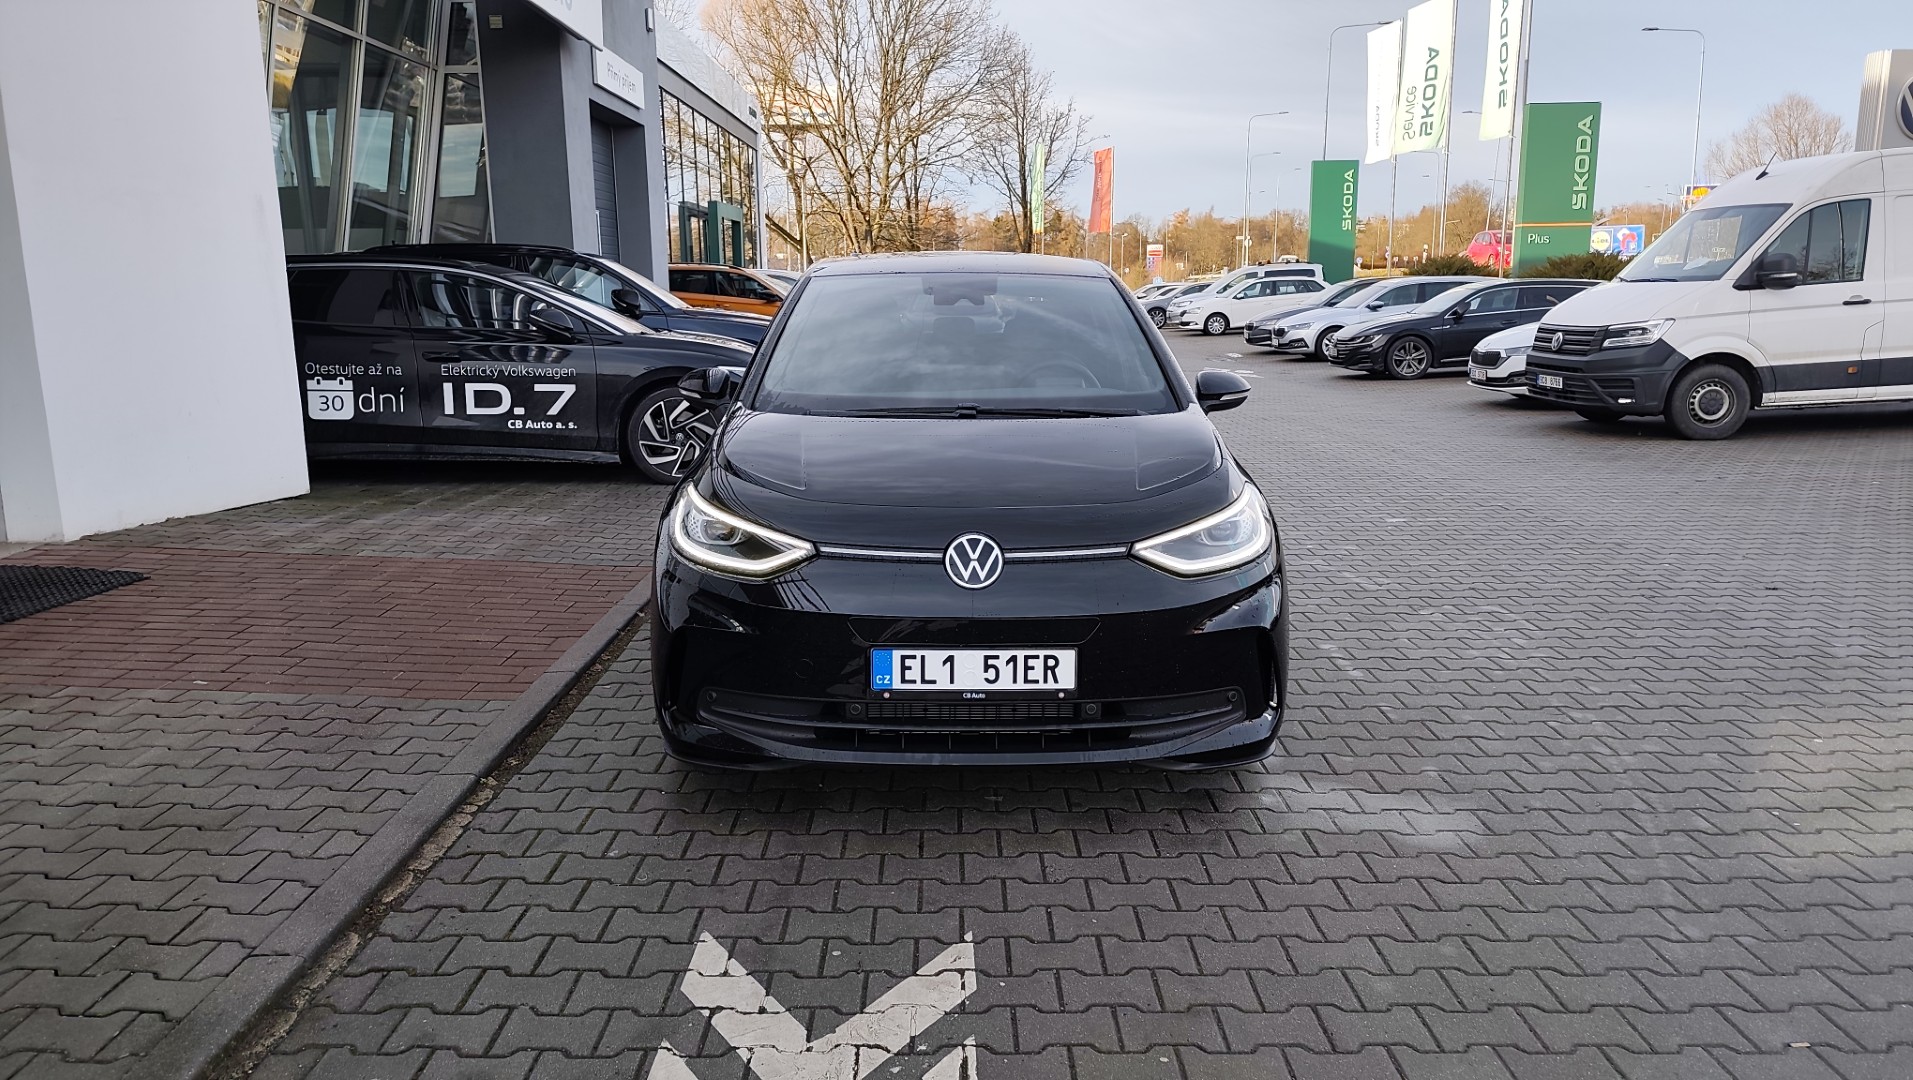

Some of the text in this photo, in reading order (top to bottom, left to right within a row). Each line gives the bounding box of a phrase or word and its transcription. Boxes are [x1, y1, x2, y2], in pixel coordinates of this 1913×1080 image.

[1527, 233, 1550, 244] Plus
[304, 362, 402, 378] Otestujte až na
[441, 364, 576, 379] Elektrický Volkswagen
[318, 386, 405, 413] 30 dní
[507, 420, 578, 429] CB Auto a. s.
[900, 654, 1060, 685] EL1 51ER
[876, 675, 891, 684] CZ
